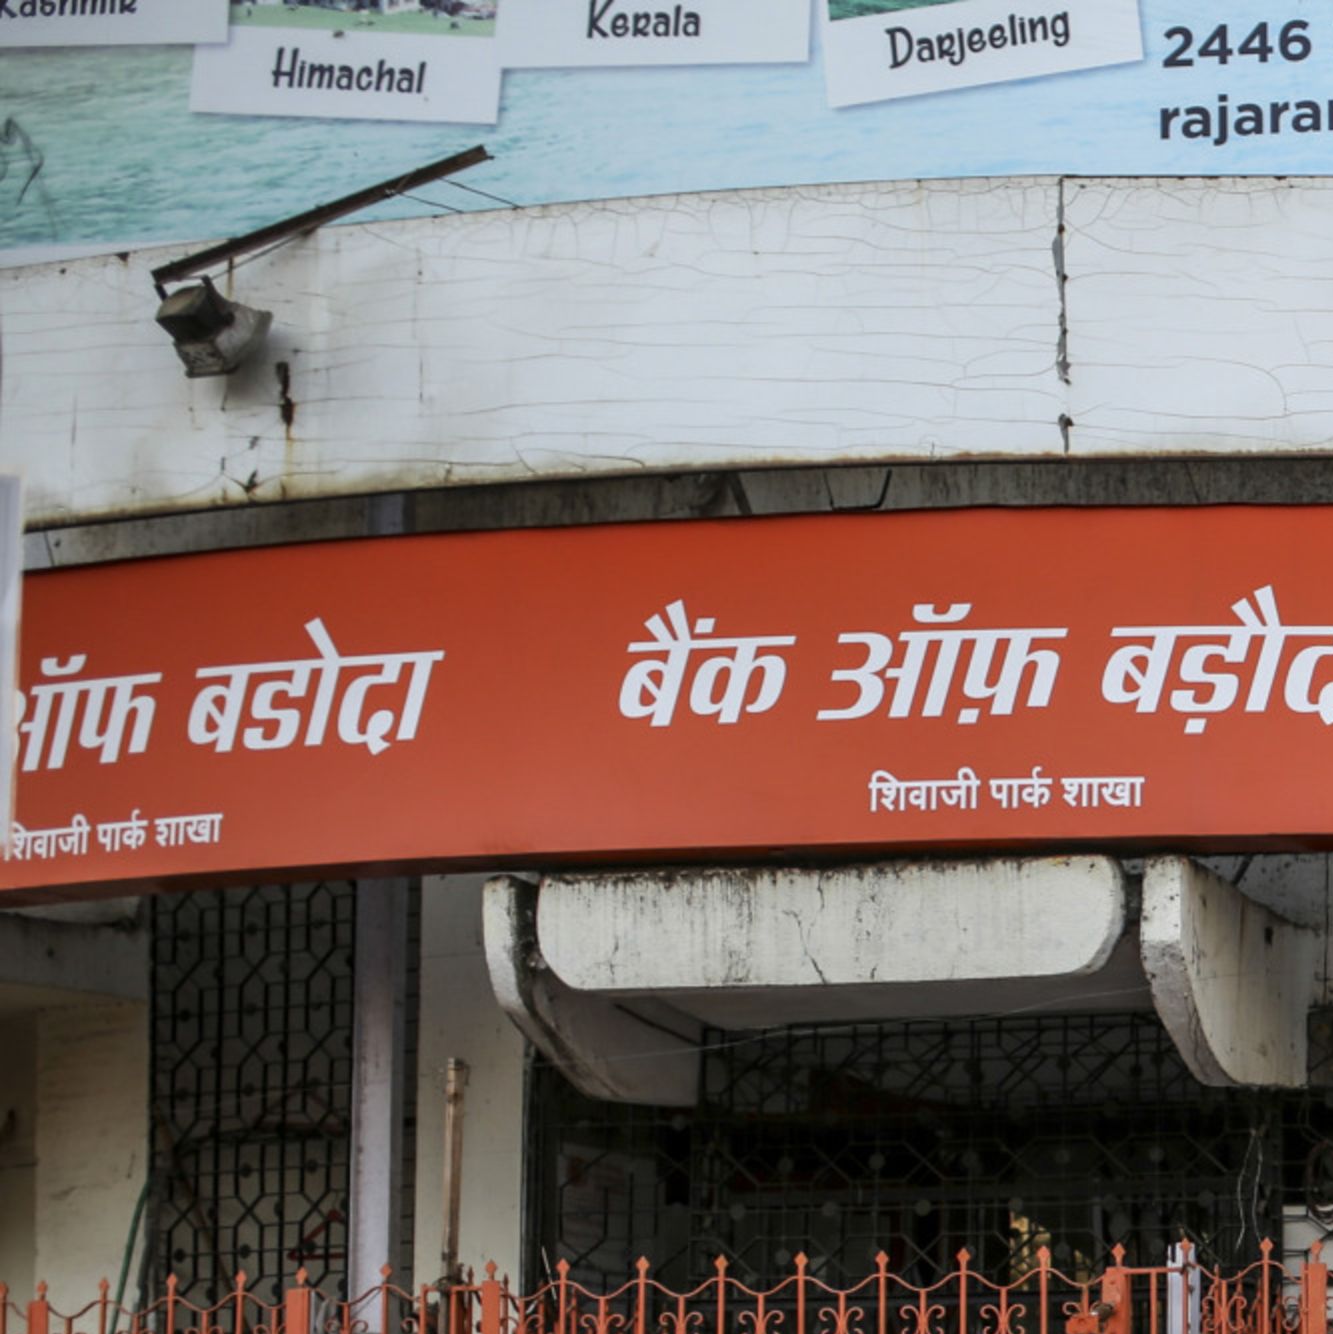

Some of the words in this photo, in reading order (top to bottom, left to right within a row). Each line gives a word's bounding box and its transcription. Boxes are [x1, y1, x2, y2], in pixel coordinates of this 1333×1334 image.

[586, 1, 702, 39] Kerala
[885, 11, 1071, 69] Darjeeling
[1162, 19, 1312, 68] 2446
[271, 48, 427, 95] Himachal
[617, 599, 796, 727] बैंक
[868, 767, 980, 812] शिवाजी
[990, 766, 1051, 810] पार्क
[1061, 776, 1145, 808] शाखा
[4, 813, 90, 861] शिवाजी
[97, 809, 149, 852] पार्क
[154, 813, 224, 847] शाखा
